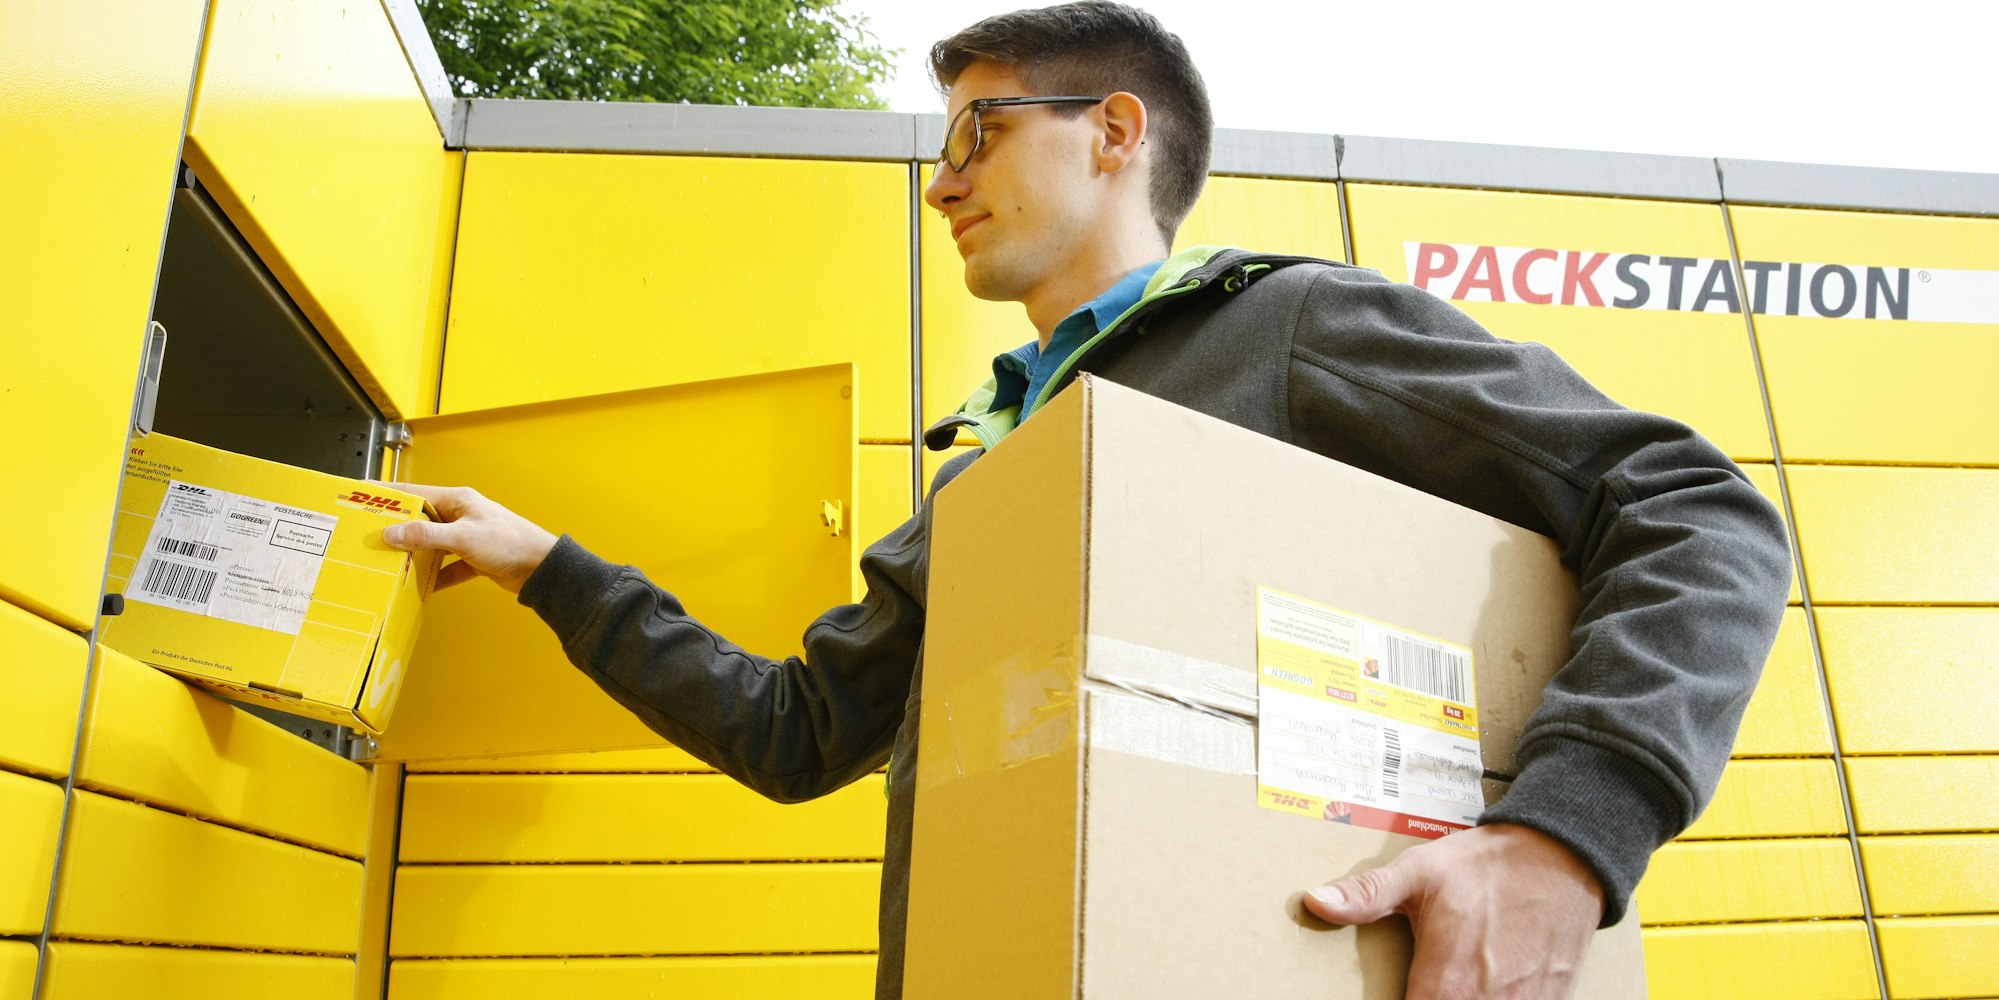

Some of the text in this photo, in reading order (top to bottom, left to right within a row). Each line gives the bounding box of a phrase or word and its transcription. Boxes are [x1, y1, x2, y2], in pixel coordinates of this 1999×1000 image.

[1413, 242, 1909, 321] PACKSTATION
[129, 456, 148, 465] Kleben
[158, 462, 172, 470] bitte
[177, 484, 207, 496] DHL
[348, 491, 402, 511] DHL
[230, 512, 264, 524] GOGREEN
[273, 506, 313, 519] POSTSACHE
[276, 534, 295, 542] Service
[288, 529, 314, 539] Postsache
[160, 651, 179, 659] Produkt
[189, 657, 216, 667] Deutschen
[1271, 668, 1313, 686] GOGREEN
[1446, 706, 1454, 715] kg
[1271, 792, 1311, 810] DHL
[1408, 819, 1448, 835] Deutschland
